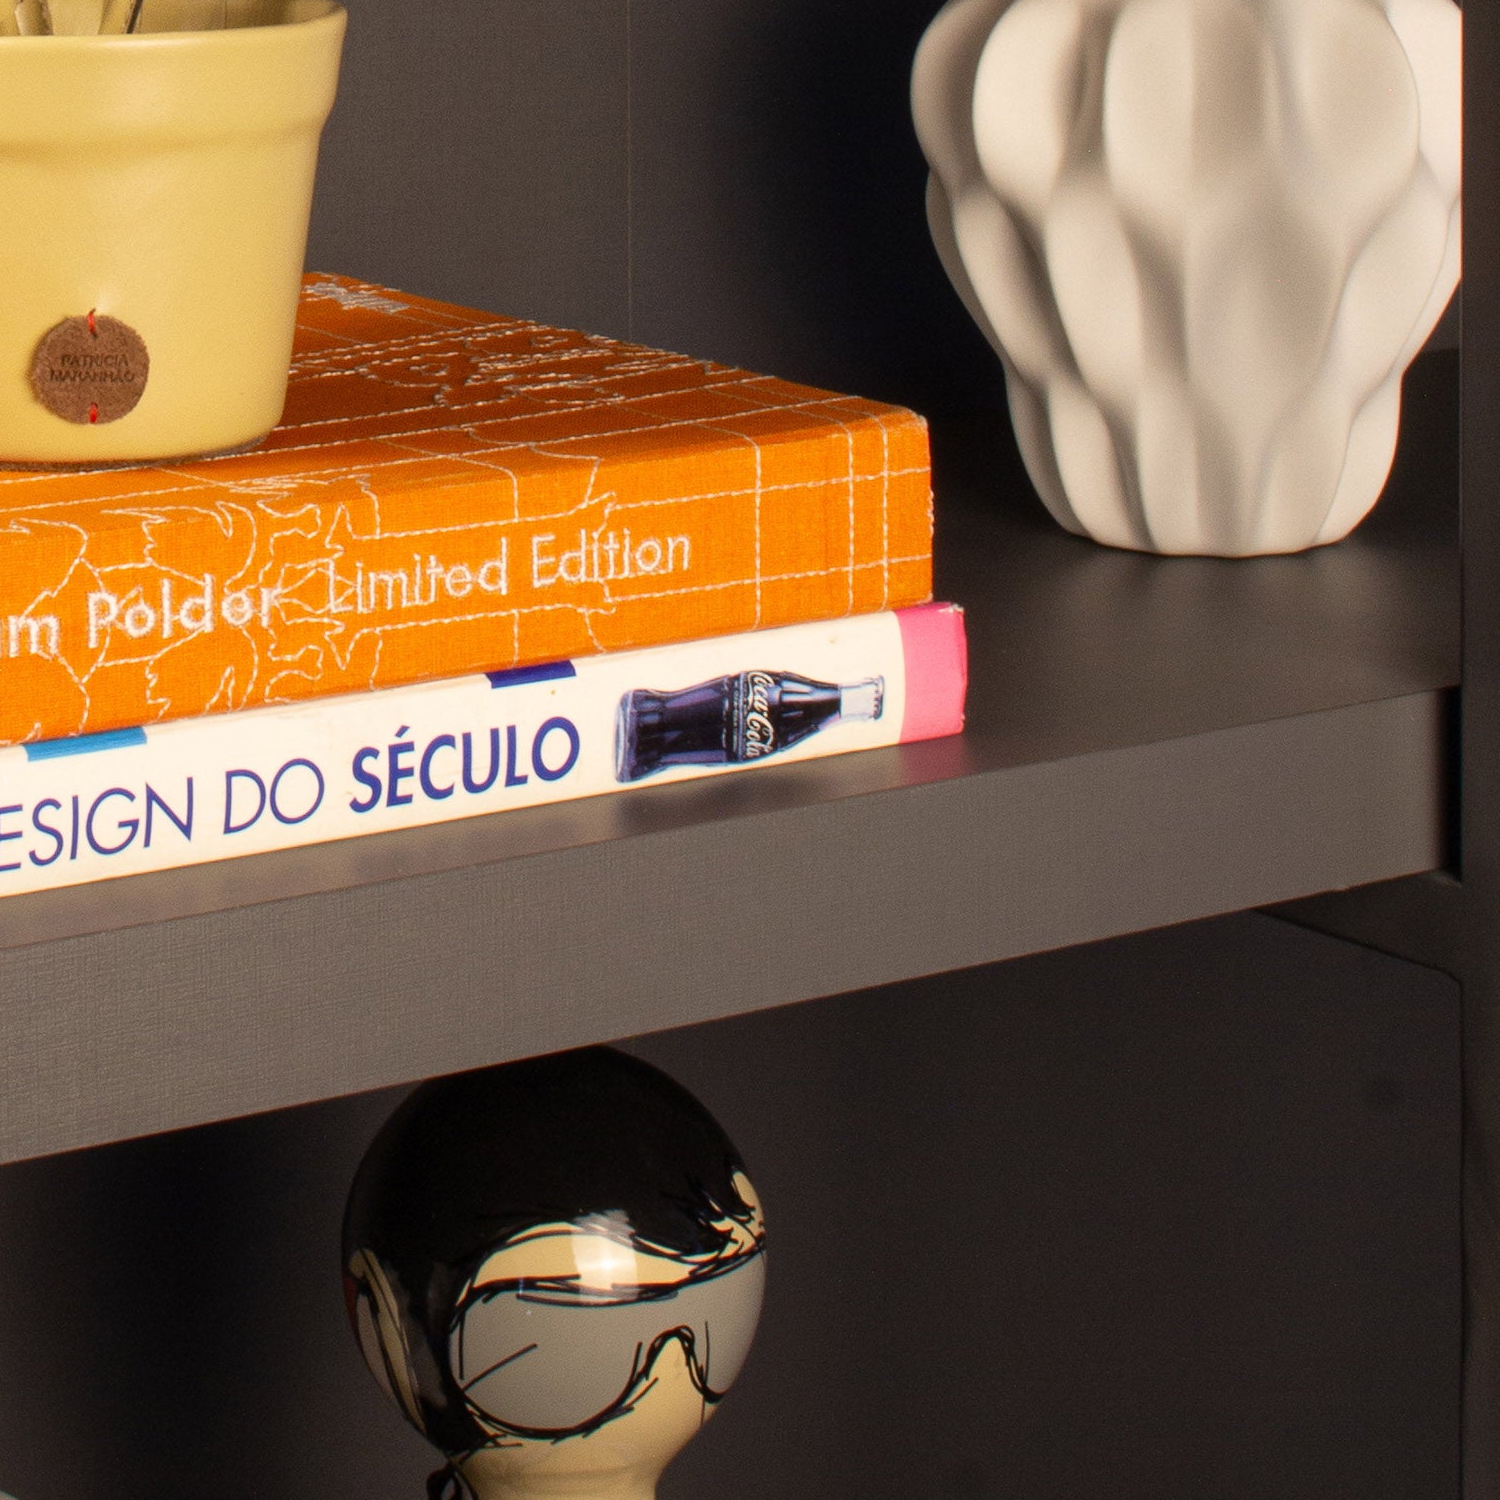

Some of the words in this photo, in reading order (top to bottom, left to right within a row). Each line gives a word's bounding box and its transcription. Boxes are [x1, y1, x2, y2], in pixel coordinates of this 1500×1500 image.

[87, 573, 280, 648] Polder
[328, 536, 508, 614] Limited
[531, 528, 691, 589] Edition
[746, 671, 776, 759] Coca-Cola
[223, 758, 325, 835] DO
[348, 716, 581, 814] SÉCULO
